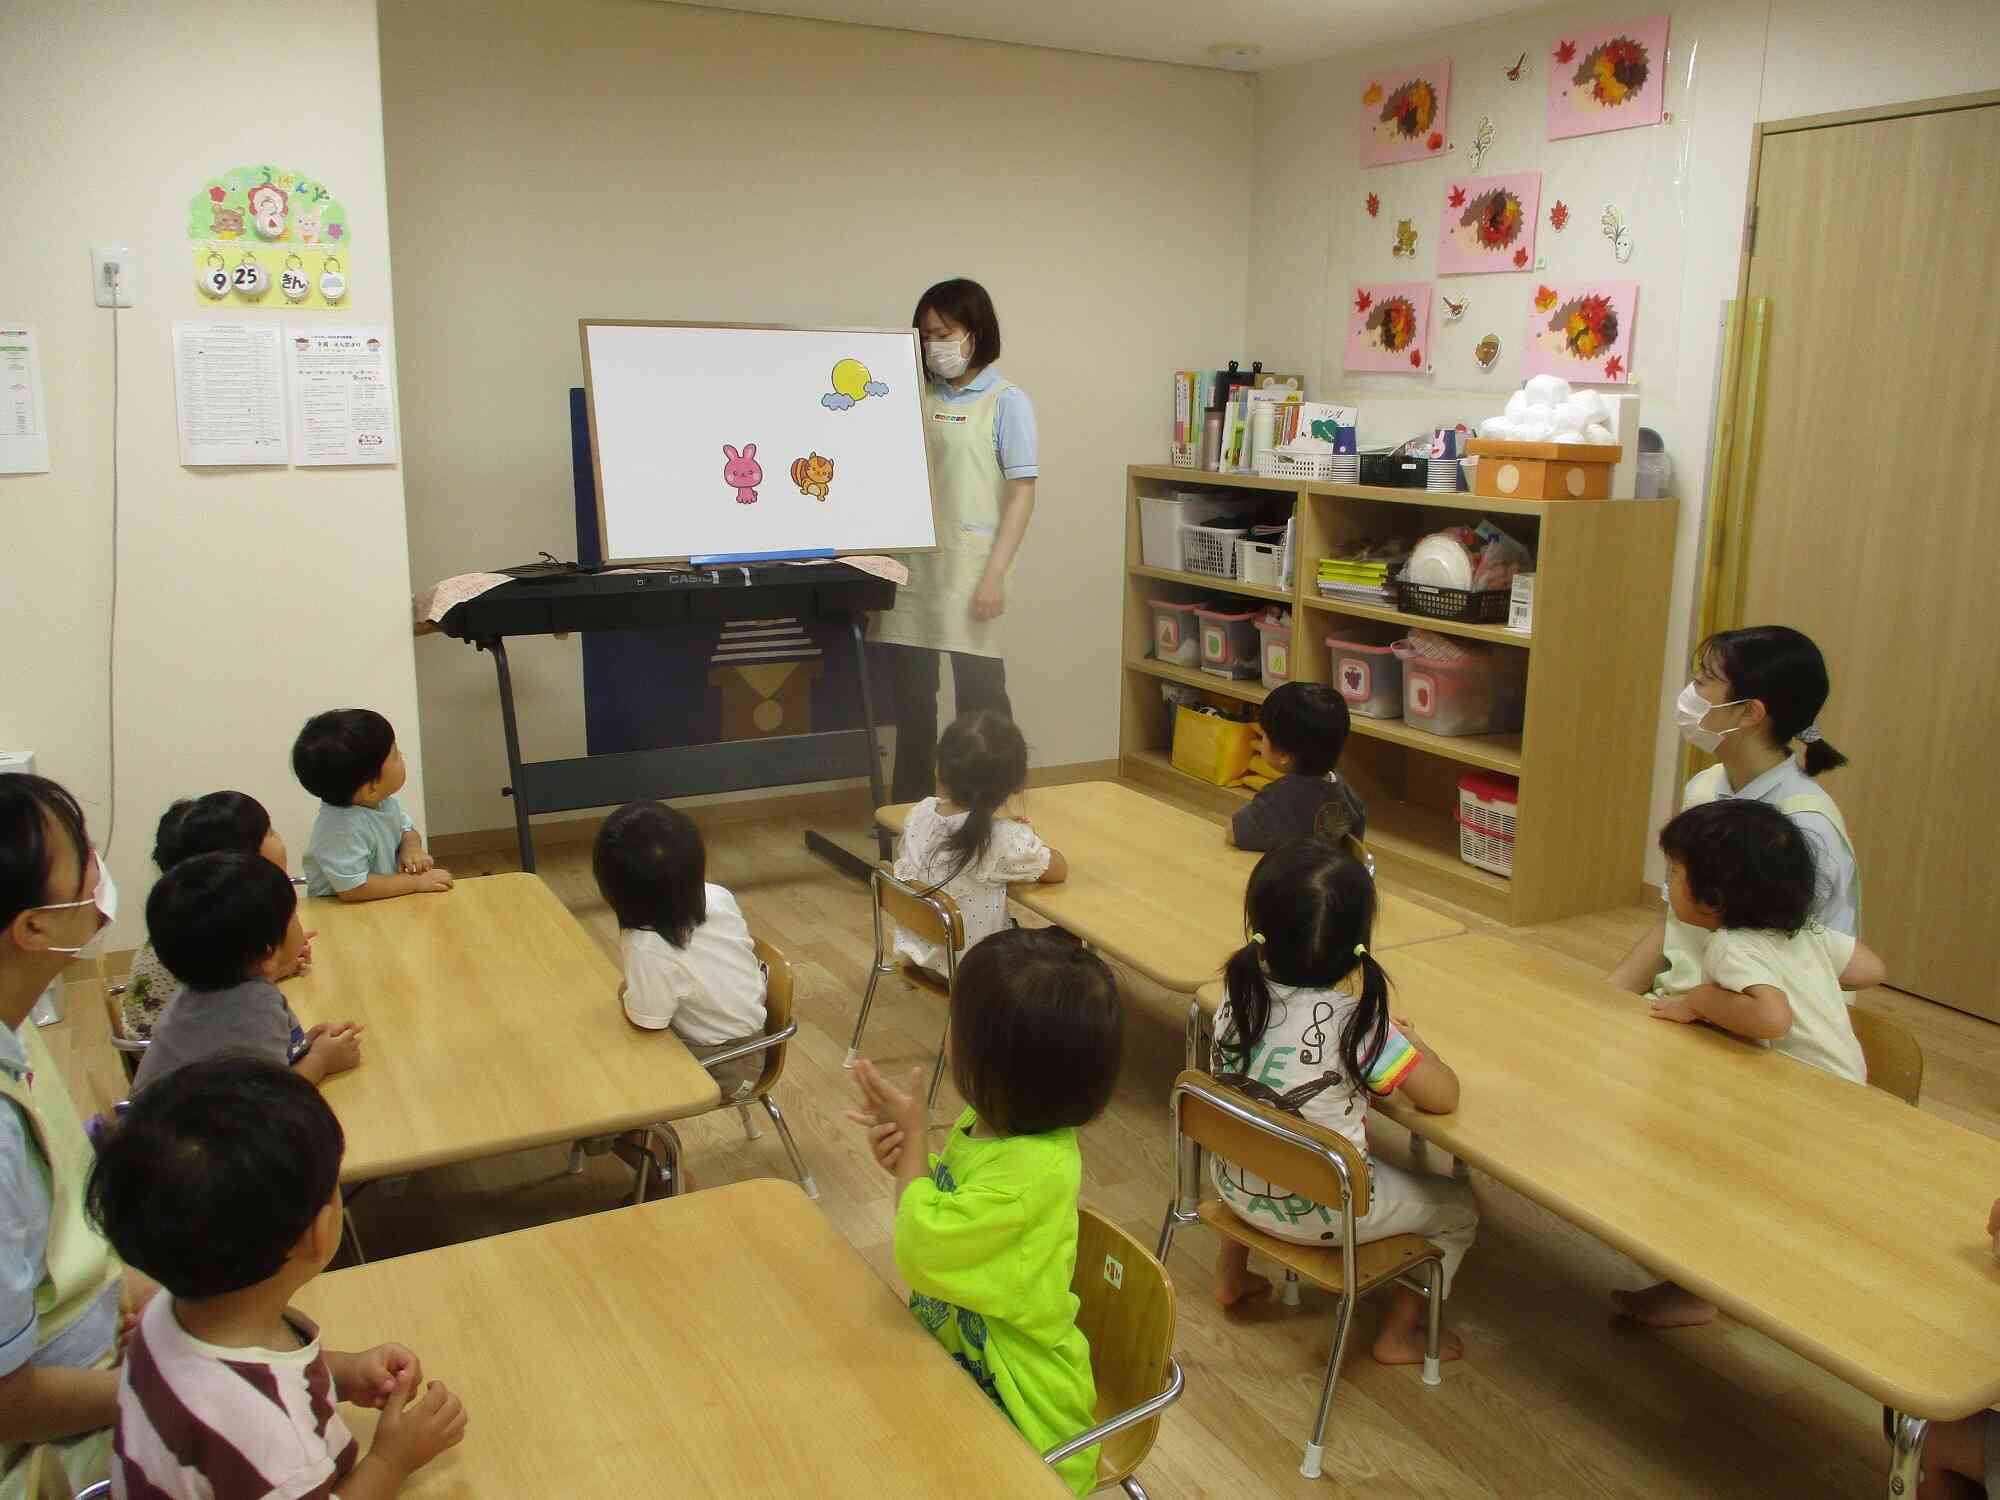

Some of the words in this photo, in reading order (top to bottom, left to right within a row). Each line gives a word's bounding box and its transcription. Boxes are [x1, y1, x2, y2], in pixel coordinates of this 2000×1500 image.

[213, 273, 226, 290] 9
[234, 269, 257, 285] 25
[282, 273, 306, 289] きん
